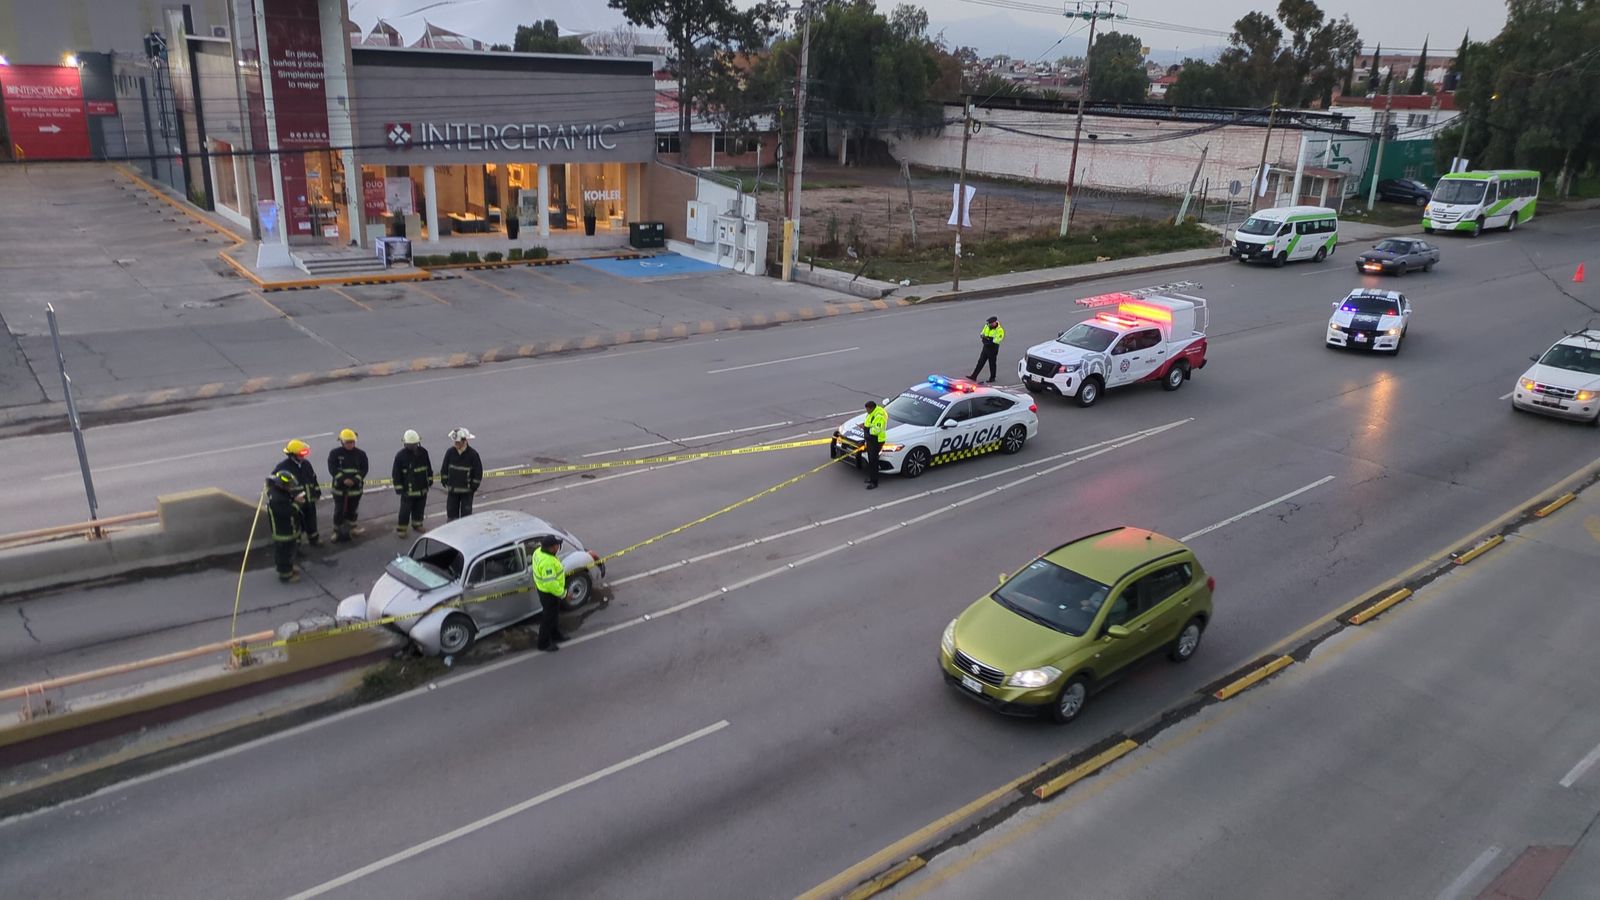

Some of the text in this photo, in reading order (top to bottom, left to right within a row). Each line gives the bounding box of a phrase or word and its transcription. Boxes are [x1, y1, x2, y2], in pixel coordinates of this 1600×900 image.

[285, 50, 295, 58] En
[273, 58, 325, 69] baños y cocin
[278, 69, 326, 79] Simplement
[288, 80, 320, 91] lo mejor
[421, 122, 617, 150] INTERCERAMIC
[365, 180, 384, 188] DUO
[584, 190, 621, 201] KOHLER
[938, 424, 1002, 454] POLICÍA
